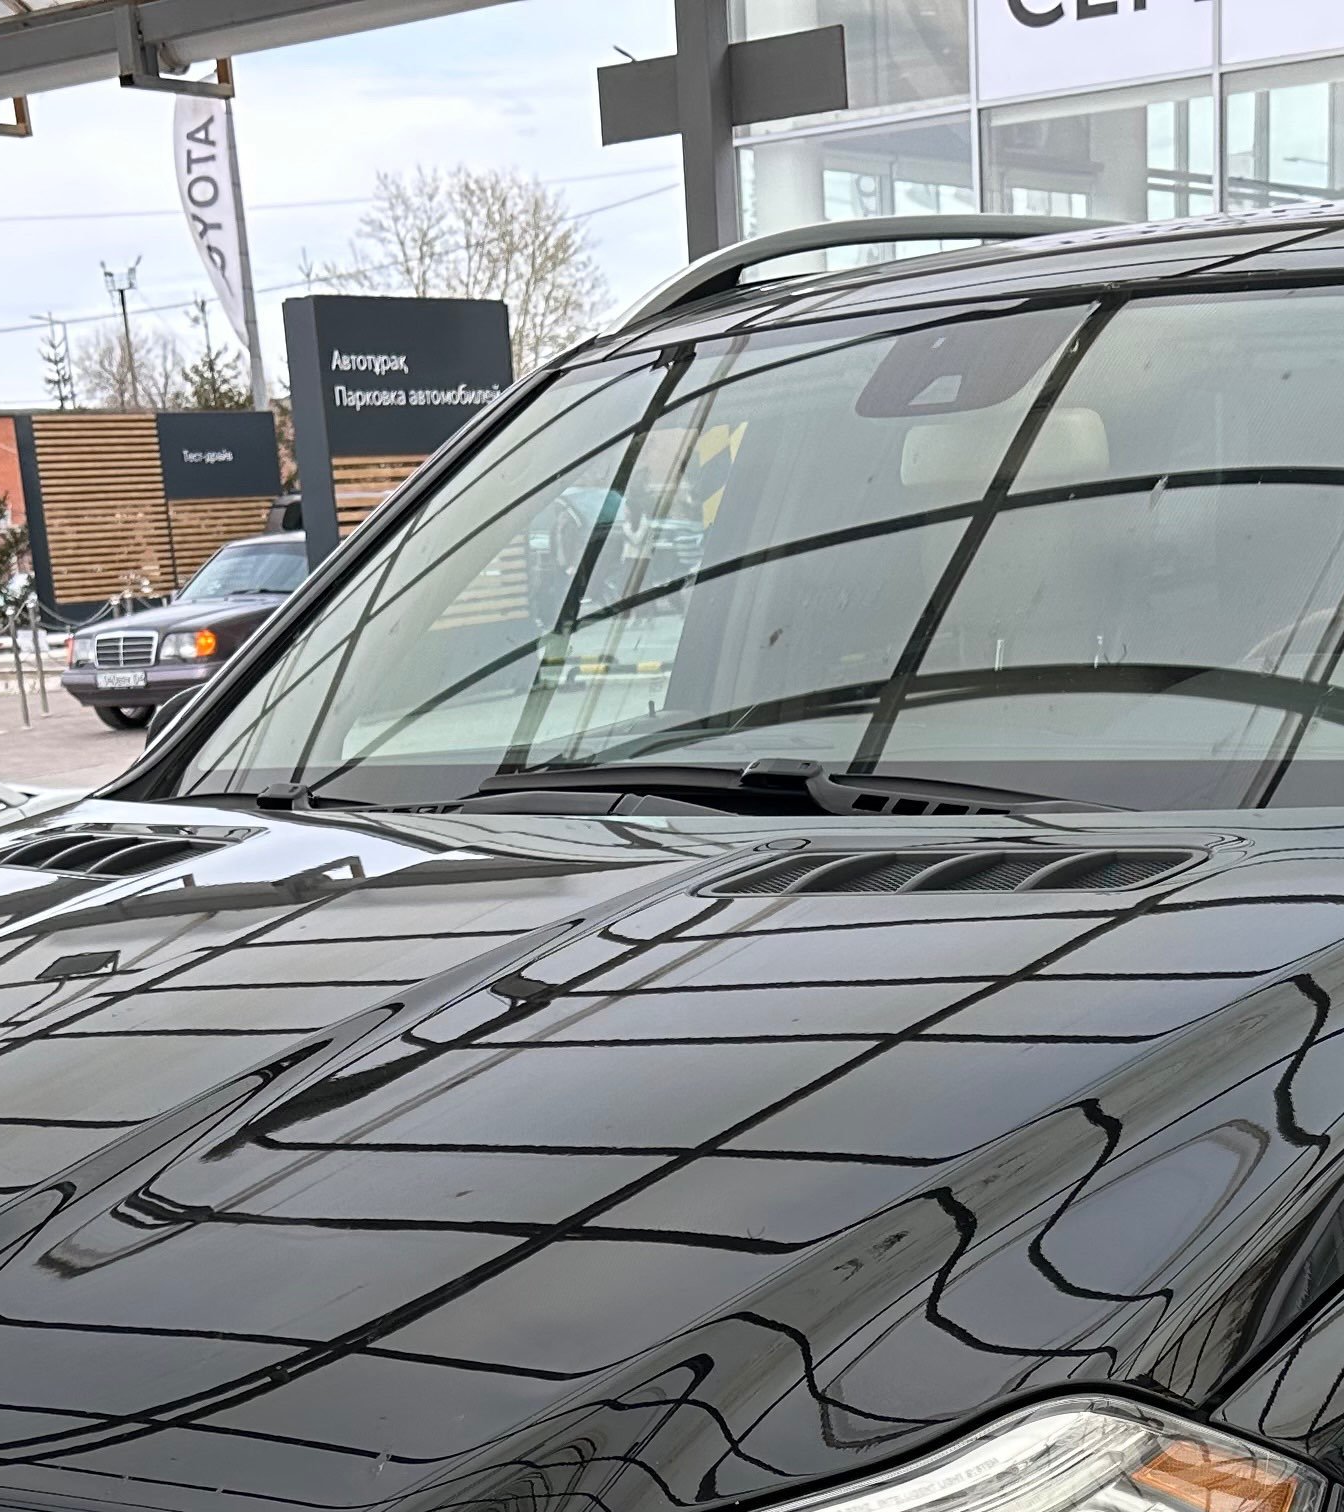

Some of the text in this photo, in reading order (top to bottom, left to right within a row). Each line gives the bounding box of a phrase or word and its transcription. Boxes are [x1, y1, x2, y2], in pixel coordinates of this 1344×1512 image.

[186, 114, 234, 297] OYOTA
[334, 384, 501, 411] Парковка автомобилей
